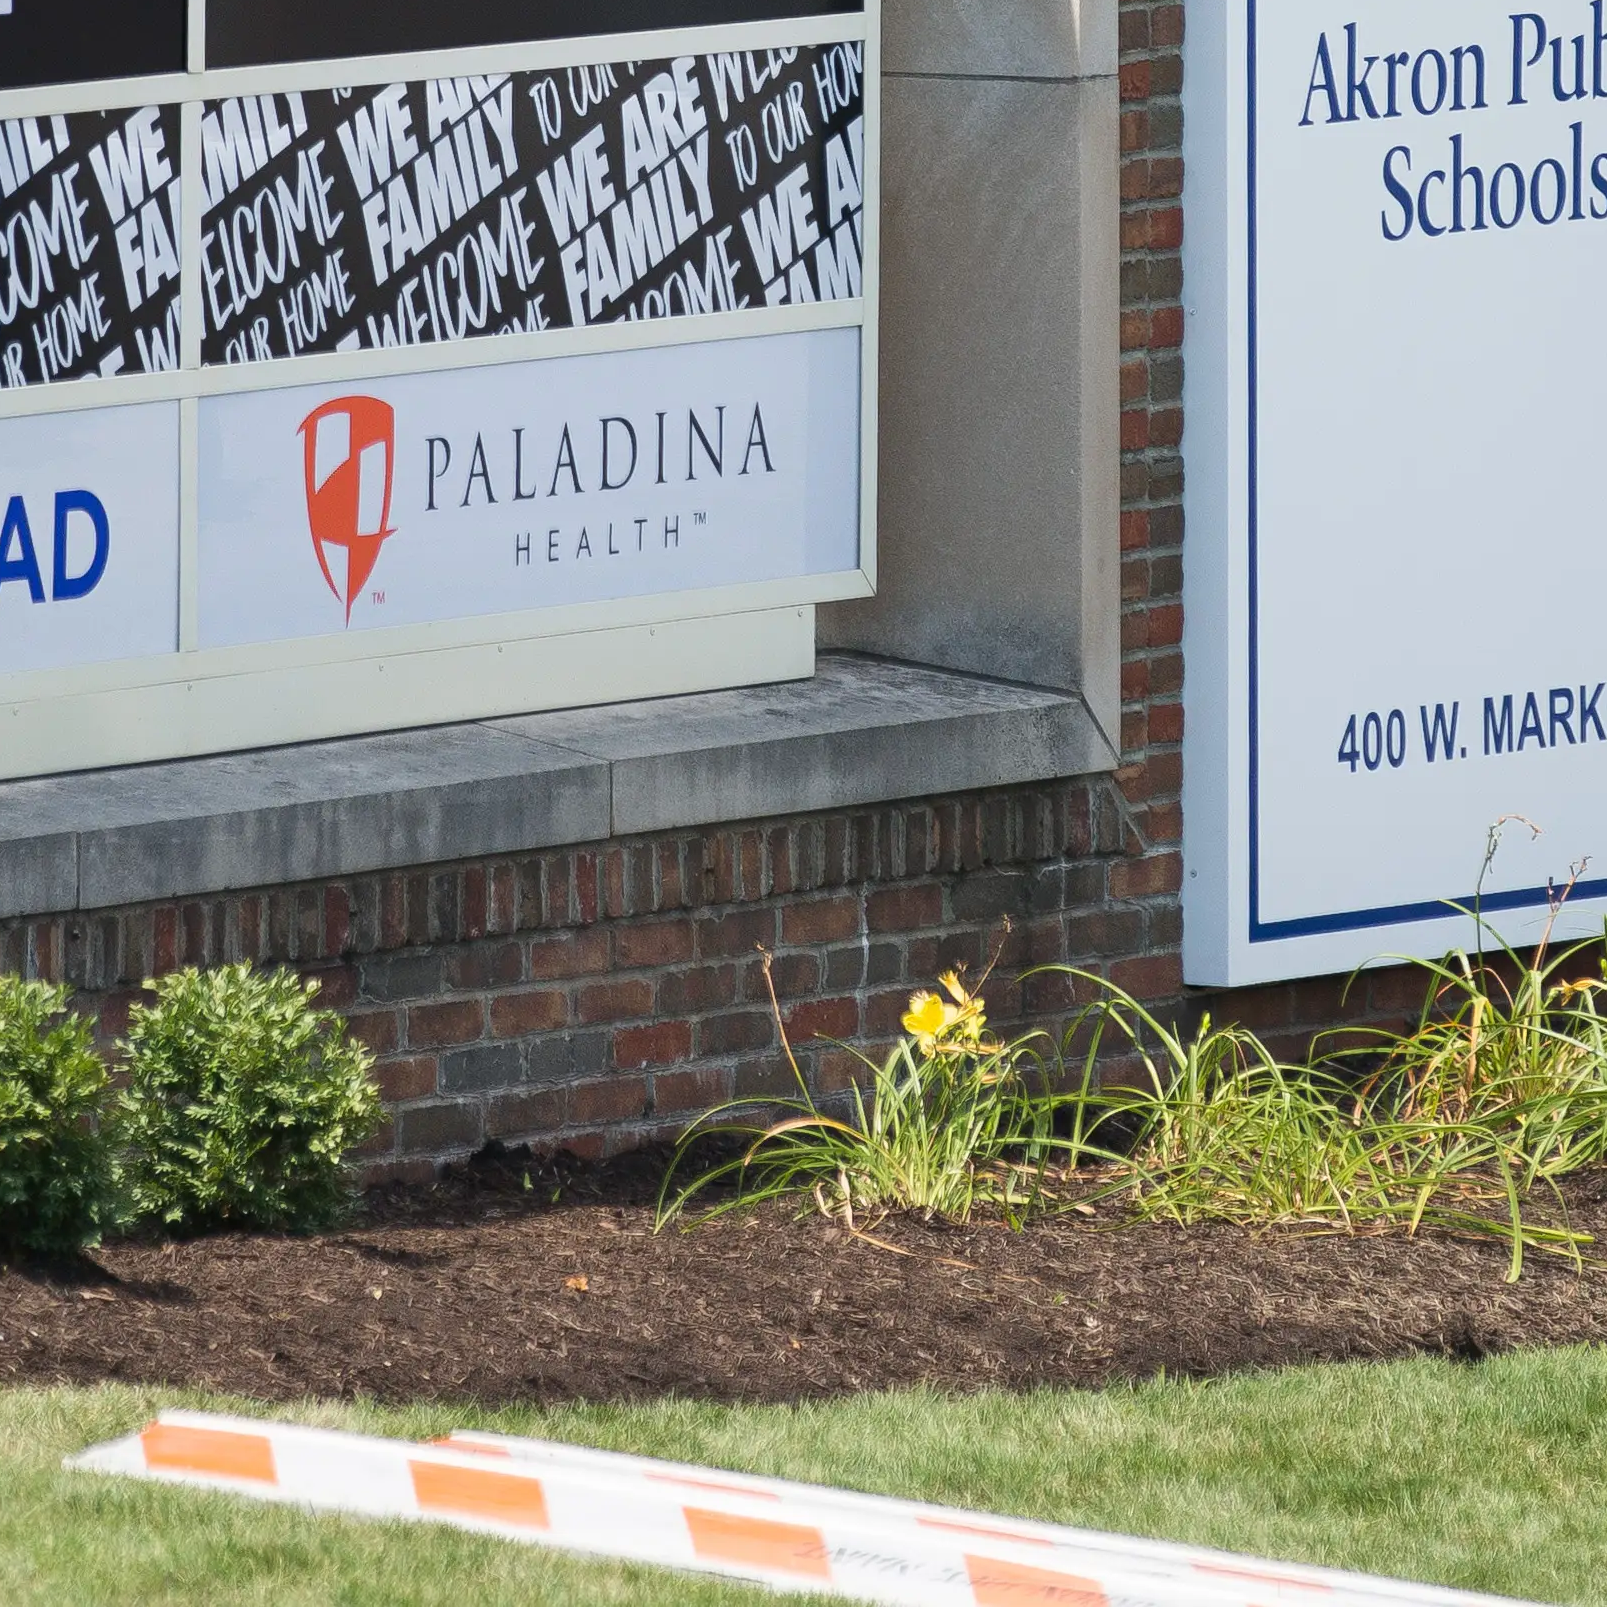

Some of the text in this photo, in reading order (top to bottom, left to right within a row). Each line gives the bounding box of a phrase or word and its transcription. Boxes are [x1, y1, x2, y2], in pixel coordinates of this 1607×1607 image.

[529, 76, 563, 146] TO
[1298, 21, 1489, 127] Akron
[88, 104, 173, 225] WE
[337, 82, 420, 201] WE
[362, 80, 520, 286] FAMILY
[536, 123, 617, 248] WE
[621, 56, 708, 191] ARE
[725, 124, 758, 193] TO
[762, 81, 813, 164] OUR
[560, 130, 714, 327] FAMILY
[741, 162, 820, 285] WE
[32, 271, 113, 383] HOME
[278, 248, 357, 358] HOME
[424, 401, 777, 512] PALADINA
[515, 514, 680, 566] HEALTH
[1337, 708, 1407, 773] 400
[1419, 701, 1467, 763] W.
